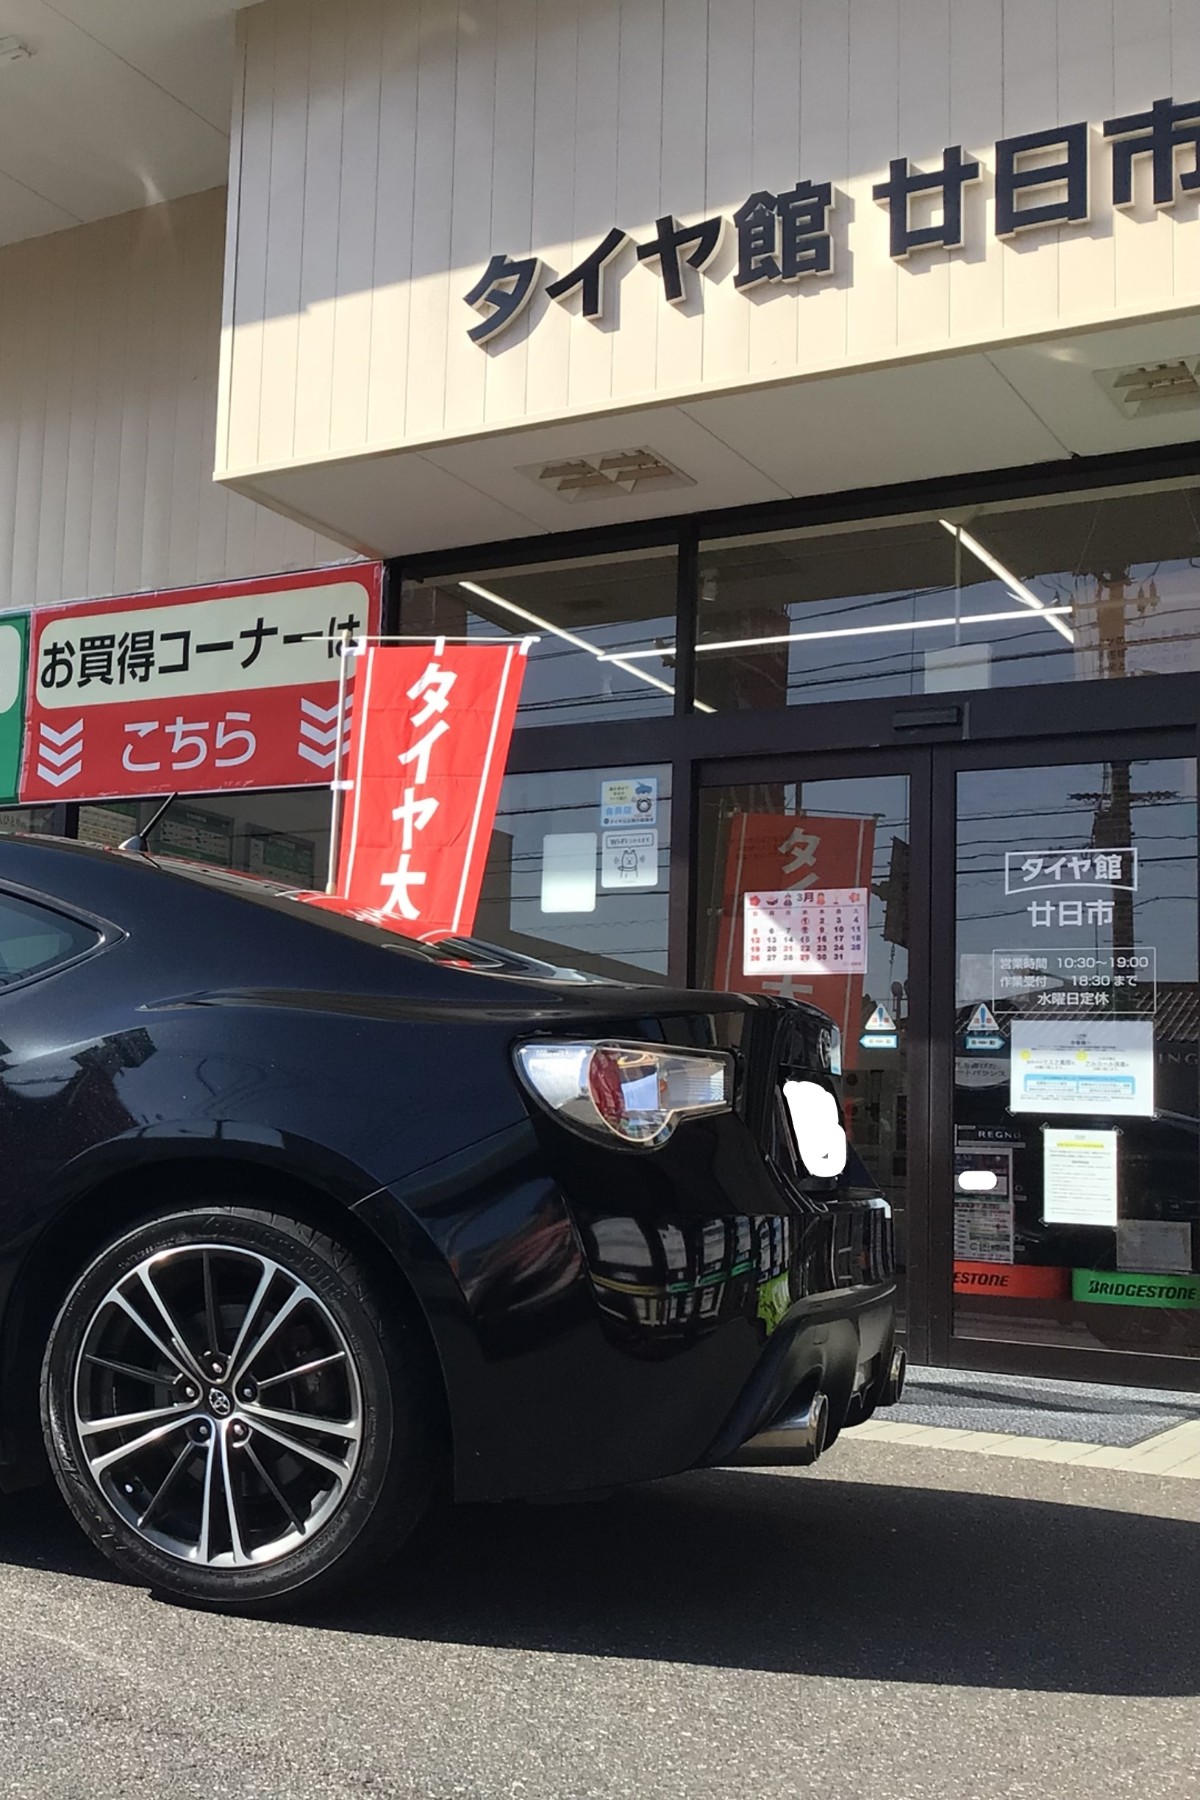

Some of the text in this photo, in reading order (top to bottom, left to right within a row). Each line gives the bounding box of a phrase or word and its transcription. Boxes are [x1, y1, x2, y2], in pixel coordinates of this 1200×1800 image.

[462, 97, 1200, 347] タイヤ館 廿日市
[40, 613, 361, 690] お買得コーナーは
[122, 711, 257, 772] こちら
[1021, 854, 1123, 882] タイヤ館
[1027, 900, 1115, 927] 廿日市
[1037, 991, 1110, 1006] 水曜日定休
[1088, 1280, 1197, 1300] BRIDGESTONE
